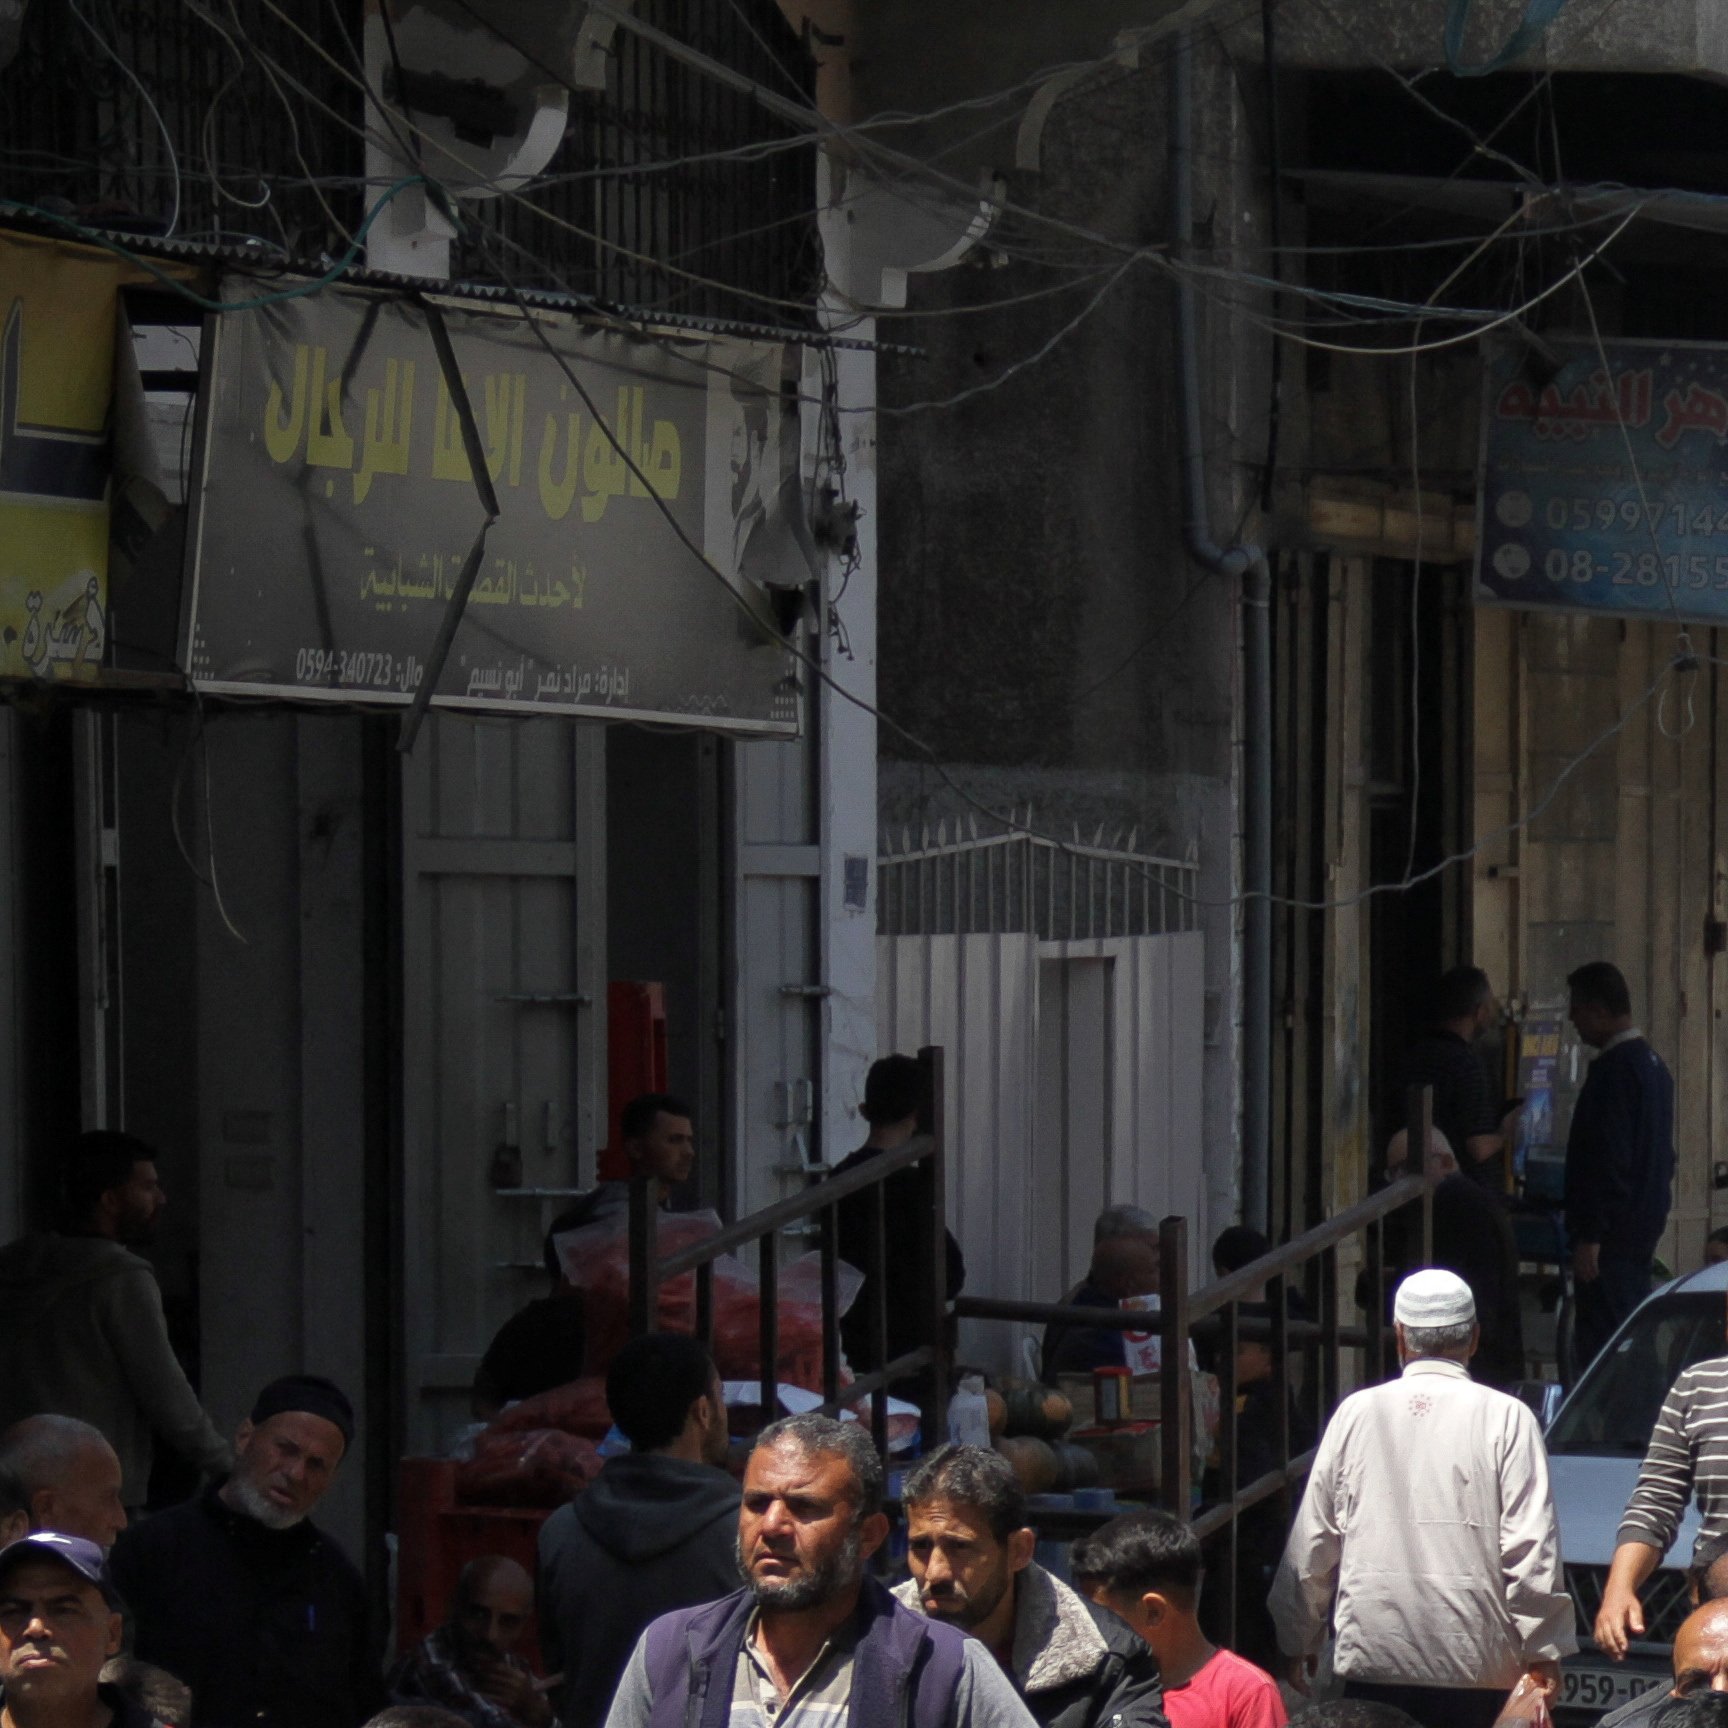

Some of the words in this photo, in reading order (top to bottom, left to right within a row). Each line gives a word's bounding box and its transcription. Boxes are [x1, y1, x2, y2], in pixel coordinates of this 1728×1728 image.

[264, 343, 416, 504] للرجال
[1496, 368, 1652, 443] النبيه
[538, 384, 682, 524] صالون
[360, 547, 445, 612] الشبابية
[445, 555, 518, 606] القصت
[519, 550, 588, 610] لأحدث
[295, 646, 393, 687] 0594-340723
